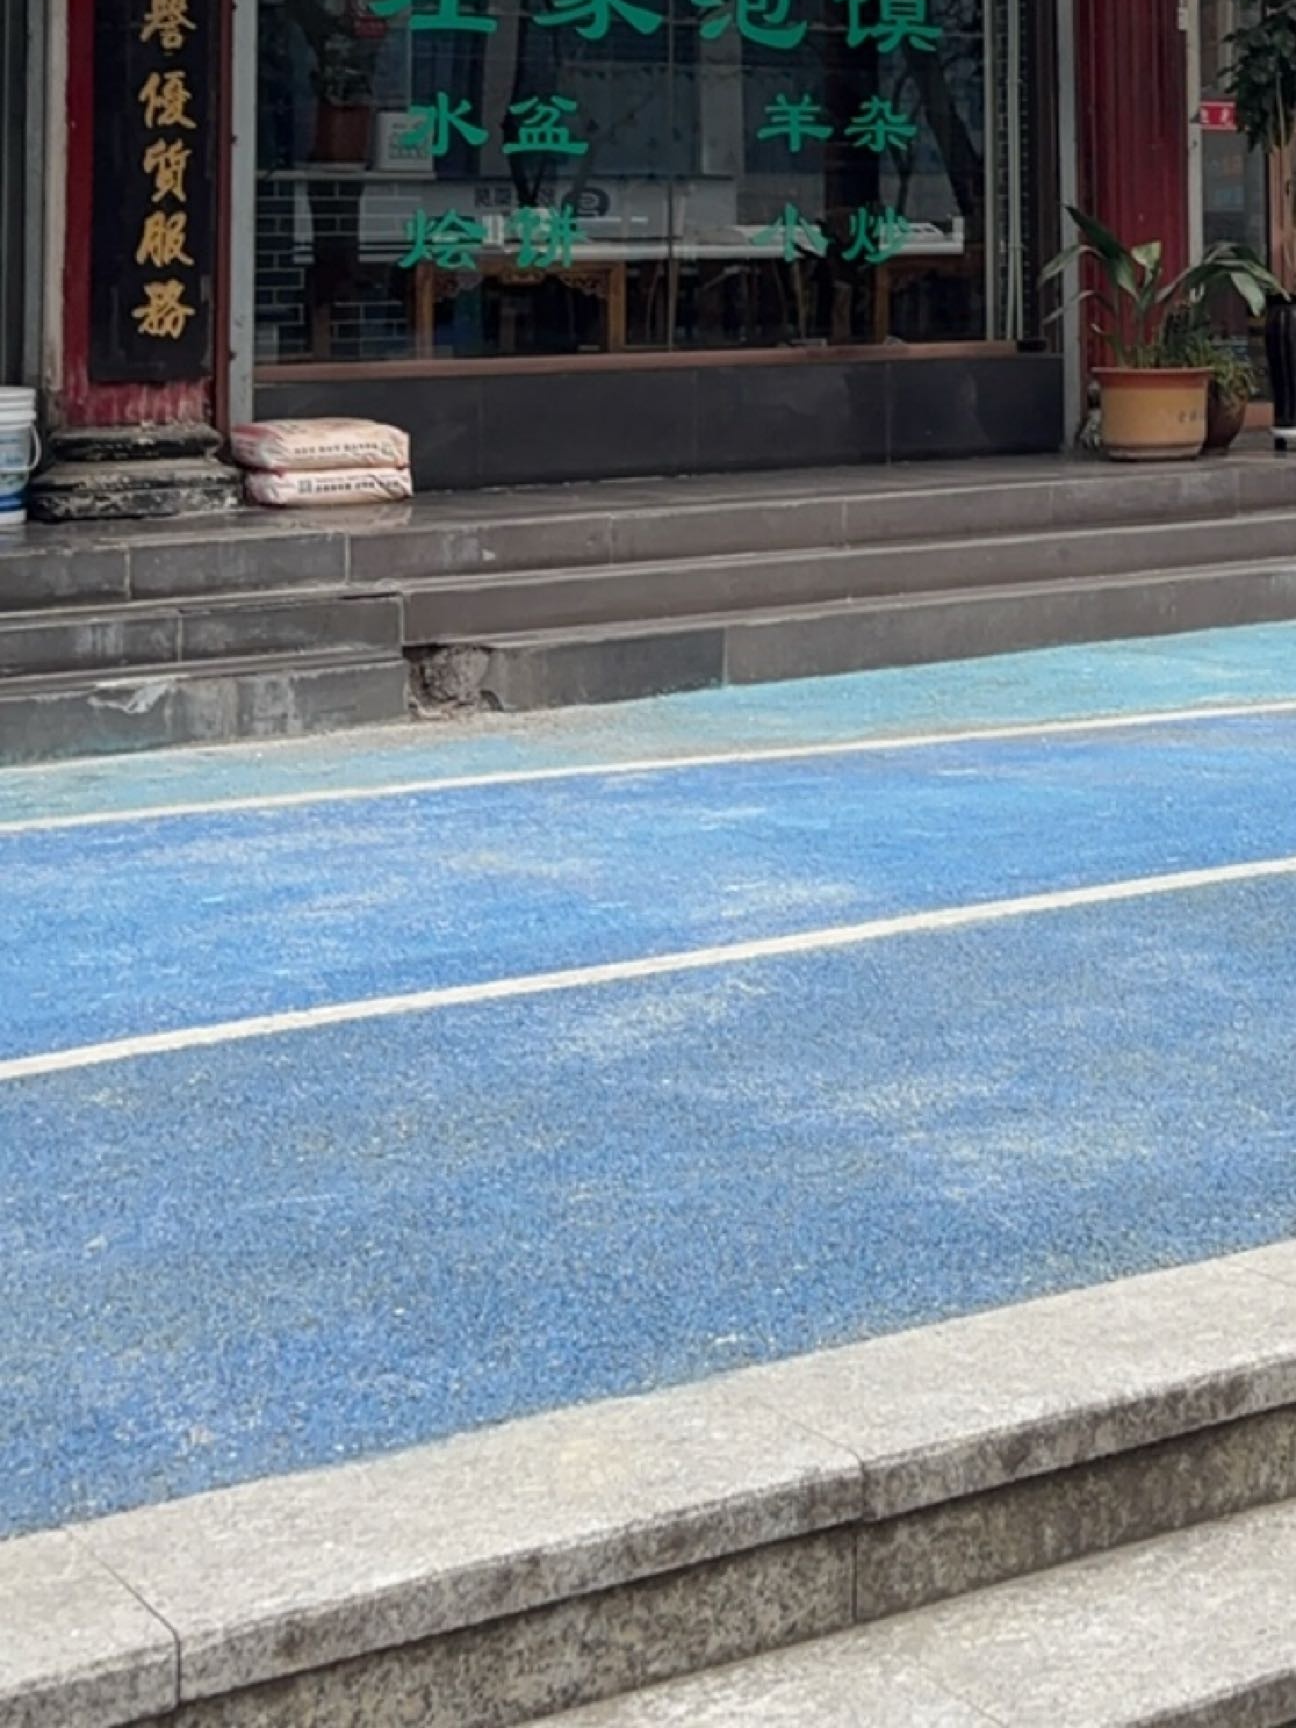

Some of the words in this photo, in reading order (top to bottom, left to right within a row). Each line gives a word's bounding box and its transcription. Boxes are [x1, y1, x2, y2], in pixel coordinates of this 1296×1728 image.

[399, 92, 590, 158] 水盆
[756, 93, 919, 154] 羊杂
[754, 203, 915, 265] 小炒
